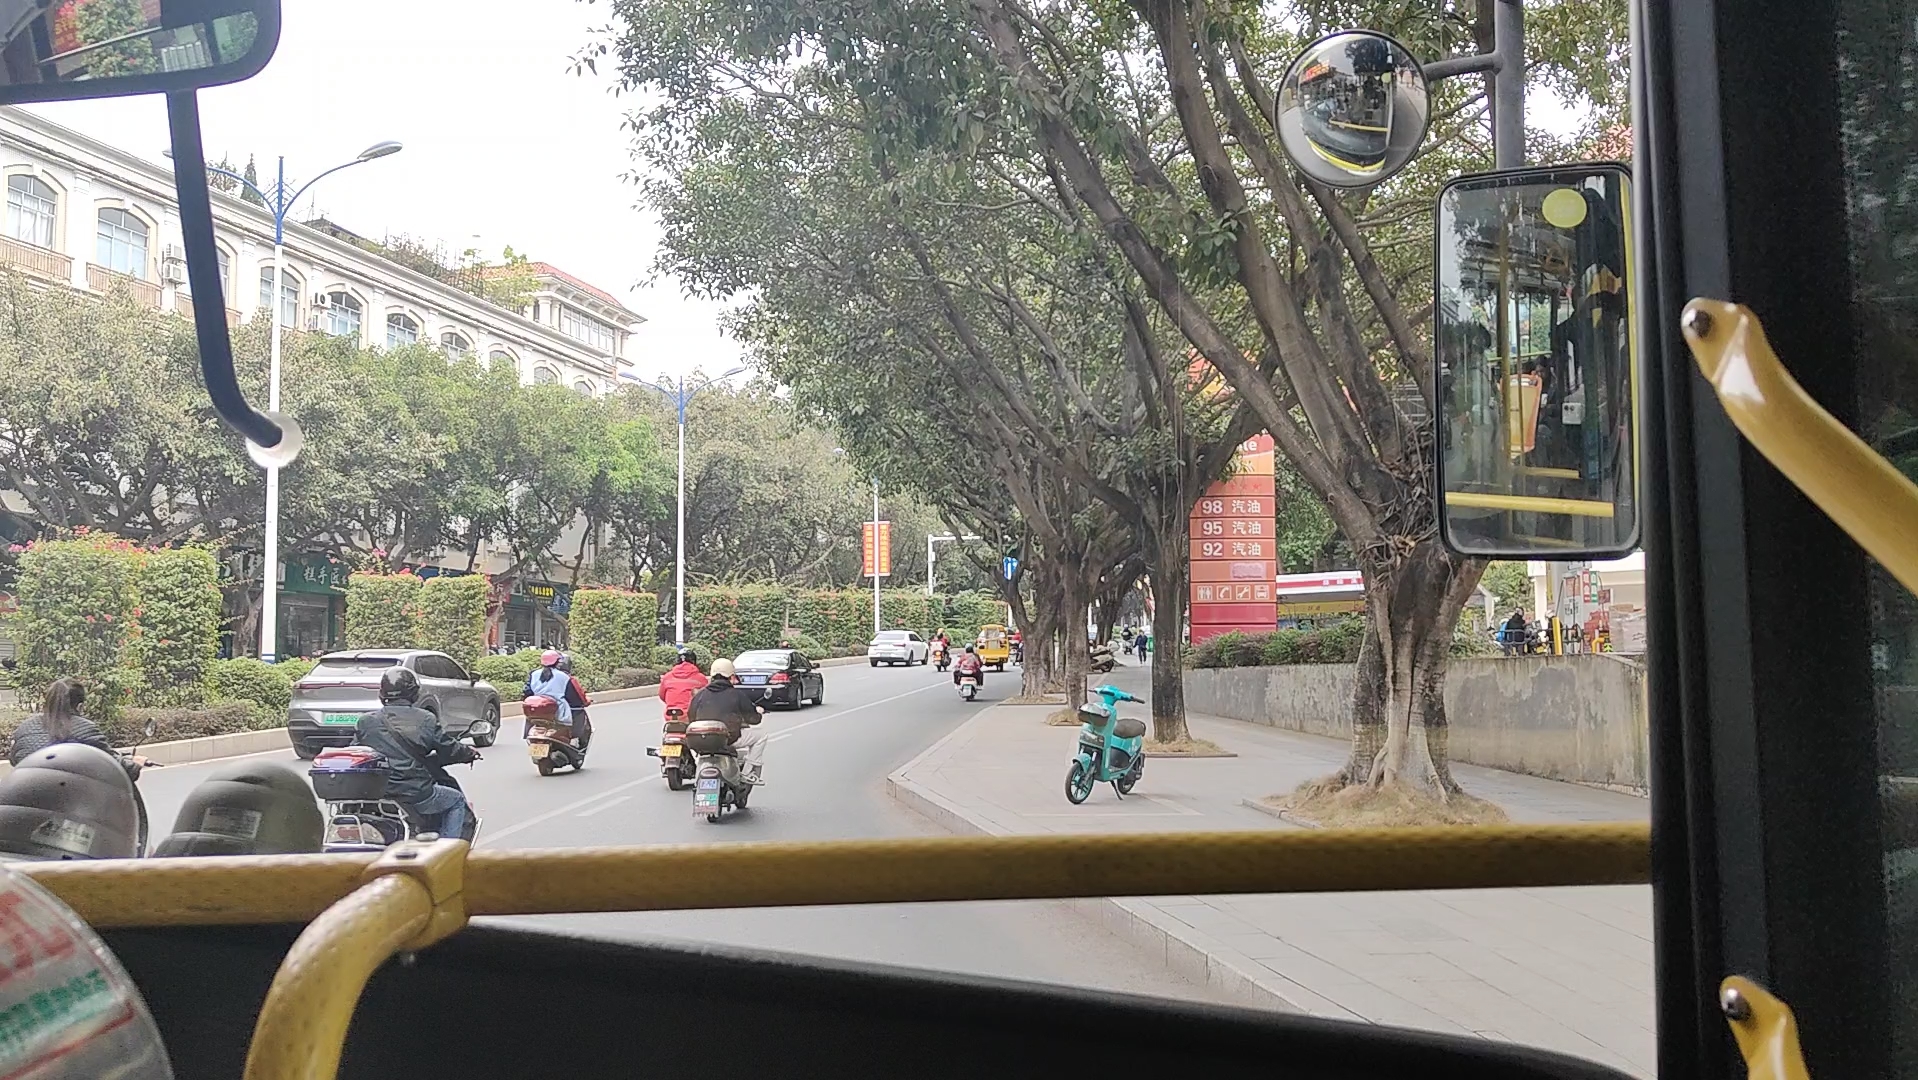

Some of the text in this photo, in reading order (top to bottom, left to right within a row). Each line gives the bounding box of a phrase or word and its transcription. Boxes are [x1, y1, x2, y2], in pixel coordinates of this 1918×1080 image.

[1202, 499, 1261, 514] 98 汽油
[1202, 520, 1262, 535] 95 汽油
[1202, 541, 1262, 556] 92 汽油
